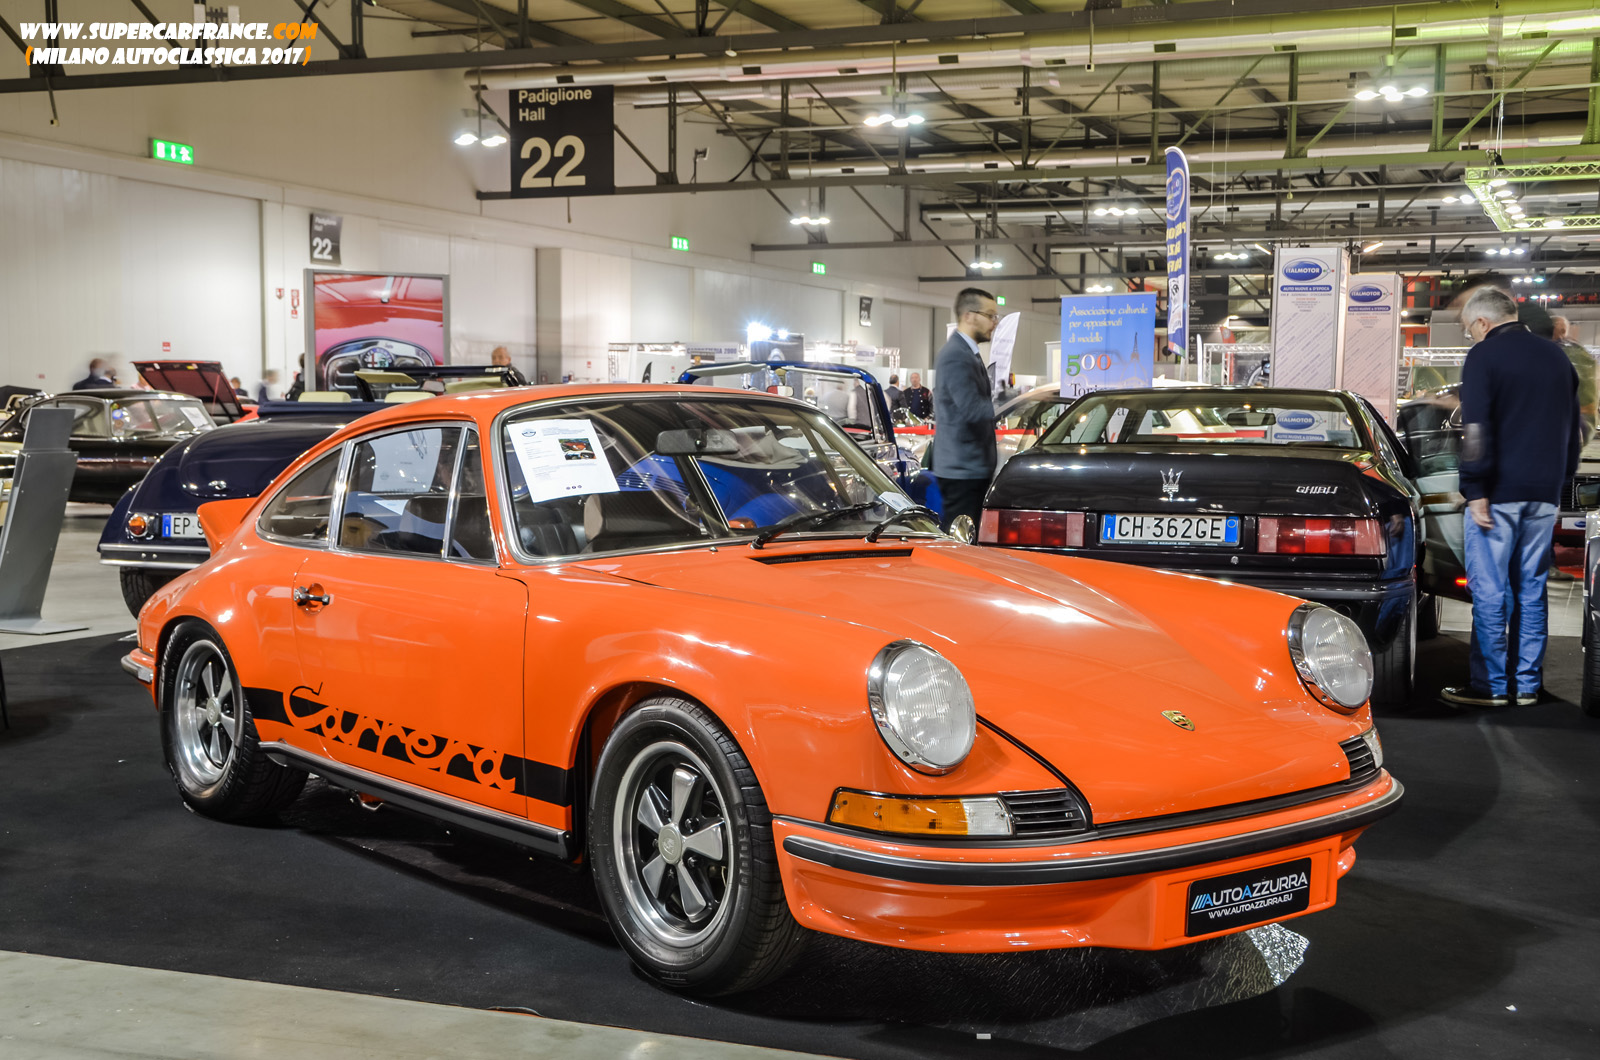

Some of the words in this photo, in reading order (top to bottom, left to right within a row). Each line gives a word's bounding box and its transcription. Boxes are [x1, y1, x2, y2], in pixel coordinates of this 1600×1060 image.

[518, 88, 592, 105] Padiglione
[518, 107, 545, 121] Hall
[520, 134, 586, 188] 22
[312, 237, 333, 260] 22
[1118, 303, 1148, 315] culturale
[1069, 320, 1082, 331] per
[1068, 333, 1076, 343] di
[1077, 331, 1104, 343] modello
[1066, 354, 1111, 376] 500
[1295, 485, 1338, 495] GHIBLI
[174, 517, 190, 535] EP
[1117, 516, 1143, 538] CH
[1152, 517, 1222, 540] 362GE
[283, 682, 516, 794] Carrera
[1198, 871, 1308, 909] AUTOAZZURRA
[1208, 893, 1293, 919] WWW.AUTOAZZURRA.EU
